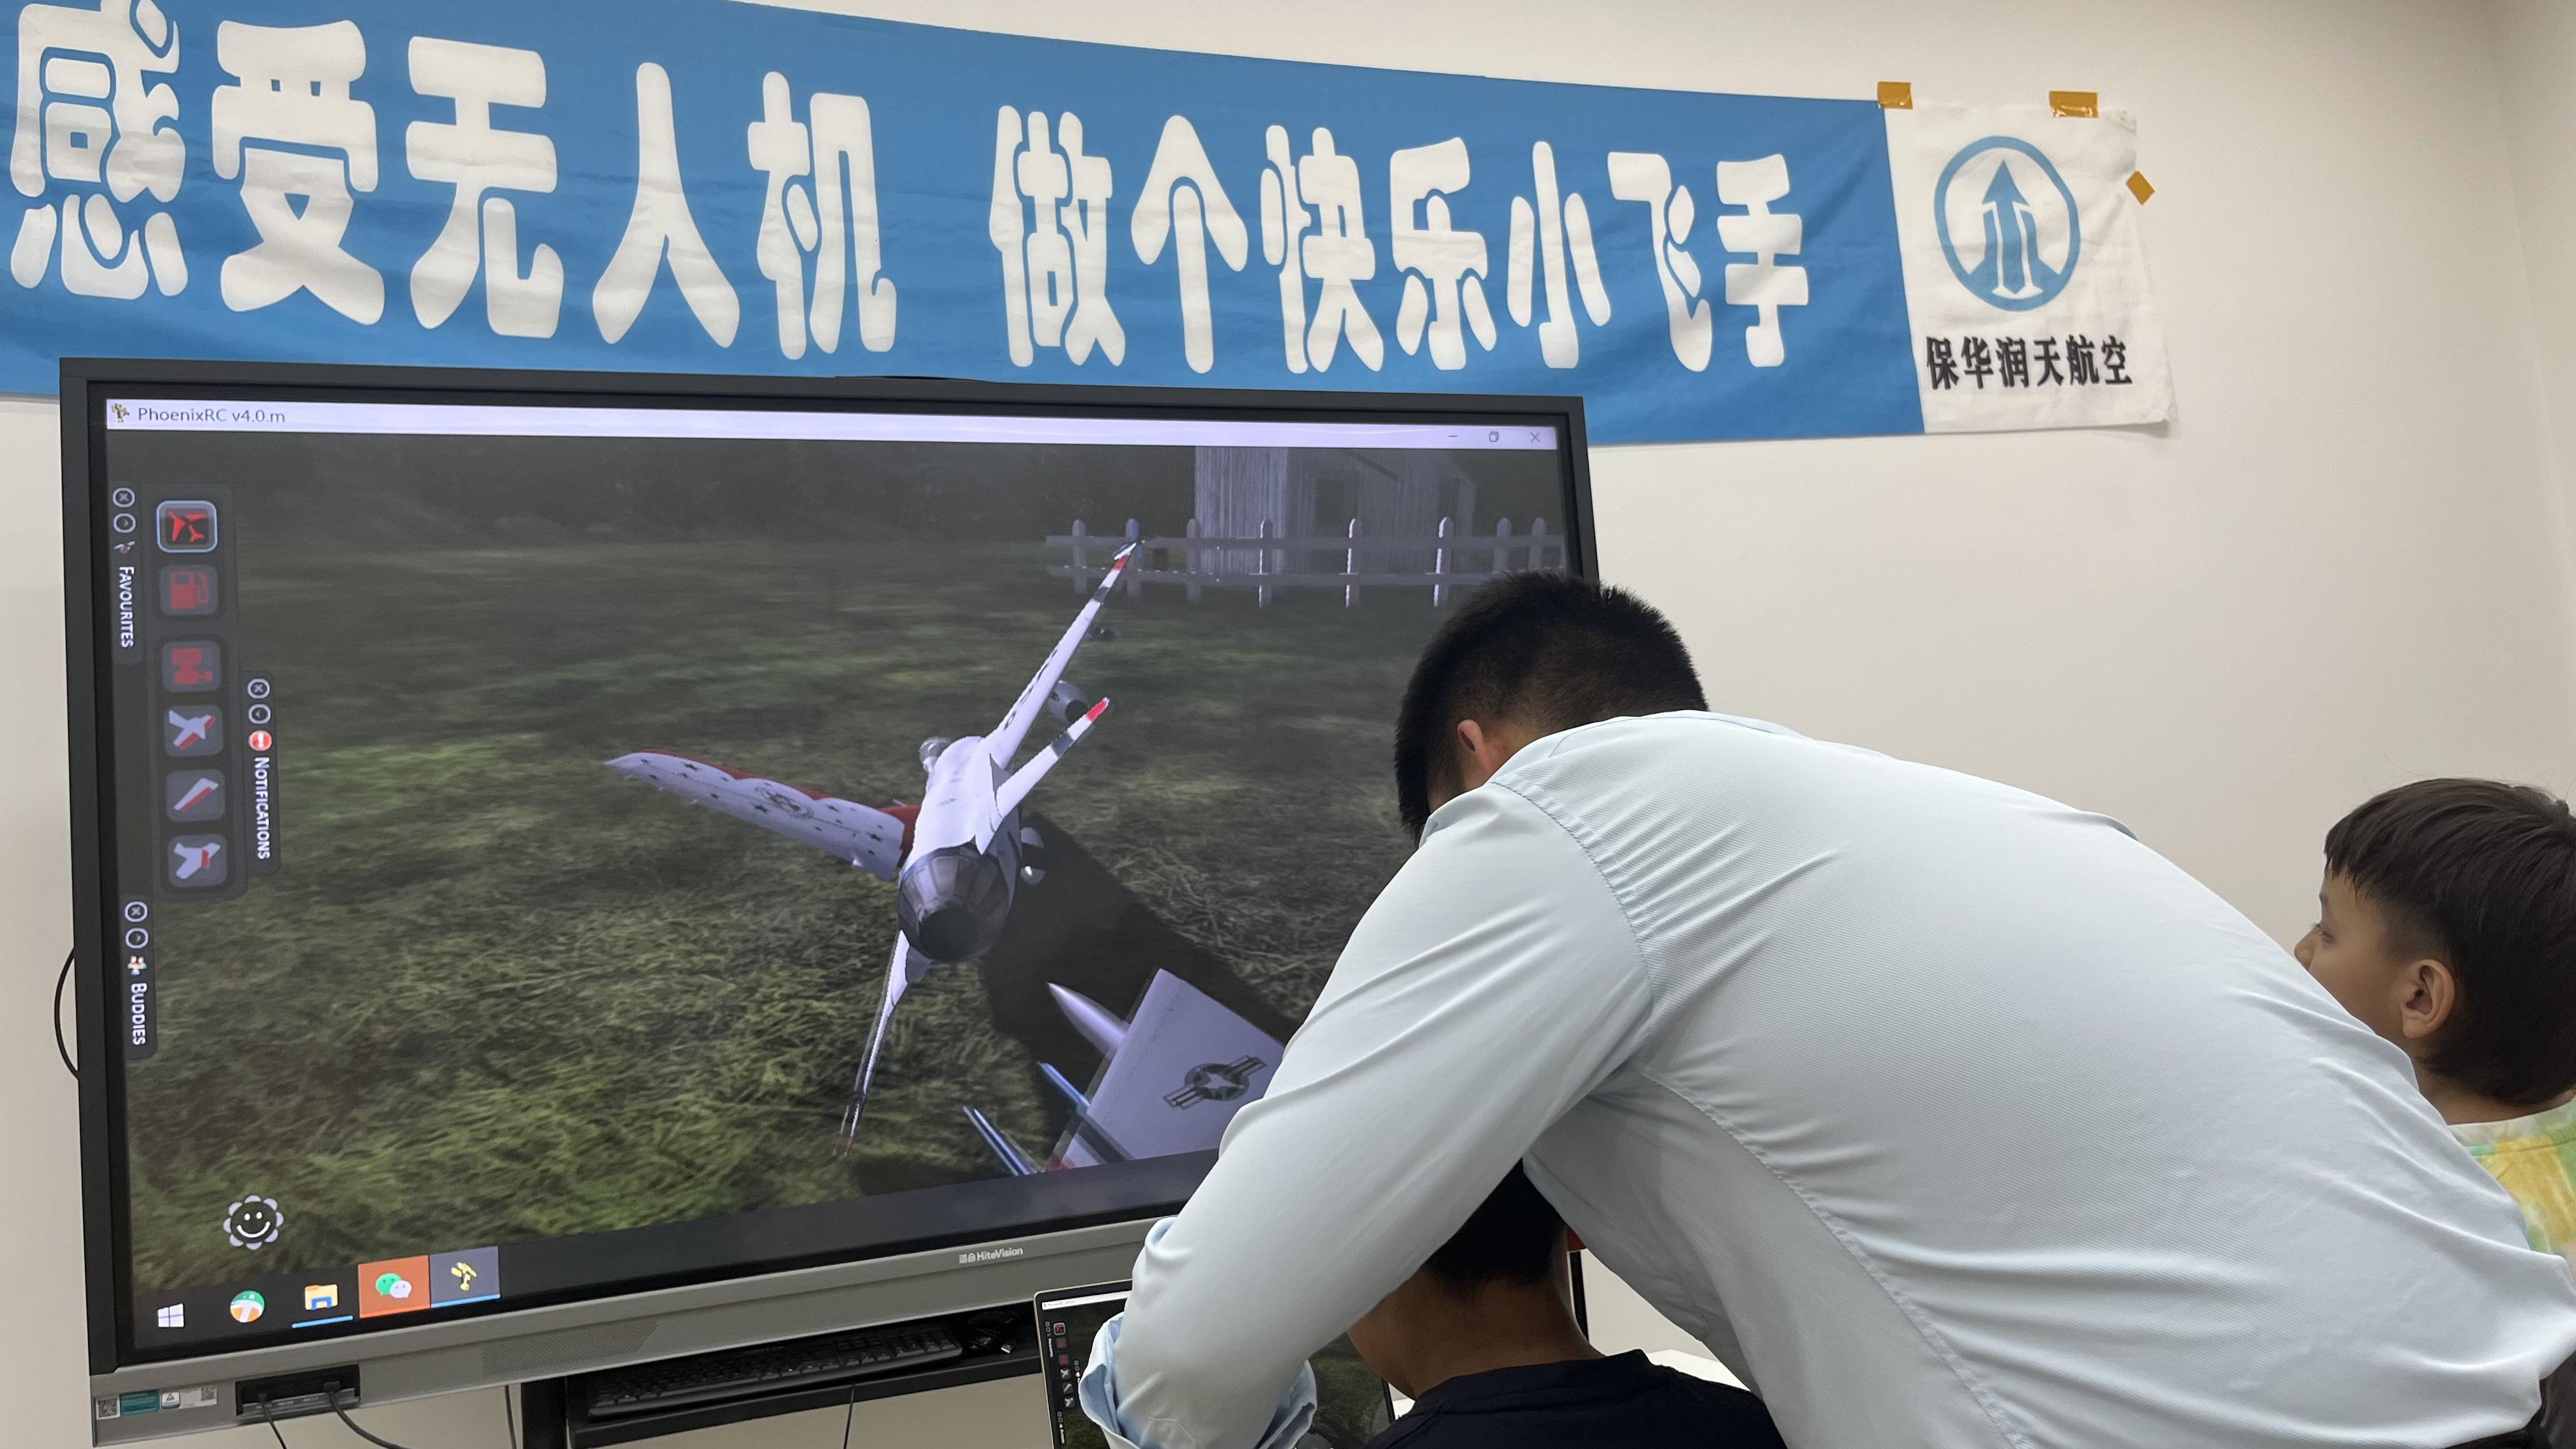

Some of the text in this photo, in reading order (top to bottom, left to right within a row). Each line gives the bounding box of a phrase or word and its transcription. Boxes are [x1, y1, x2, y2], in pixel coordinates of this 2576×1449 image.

[10, 0, 1809, 374] 感受无人机 做个快乐小飞手
[1926, 334, 2133, 390] 保华润天航空
[138, 407, 286, 423] PhoenixRC v4.0.m
[118, 566, 135, 648] FAVOURITES
[254, 756, 271, 861] NOTIFICATIONS
[131, 982, 148, 1046] BUDDIES
[976, 1247, 1023, 1262] HiteVision
